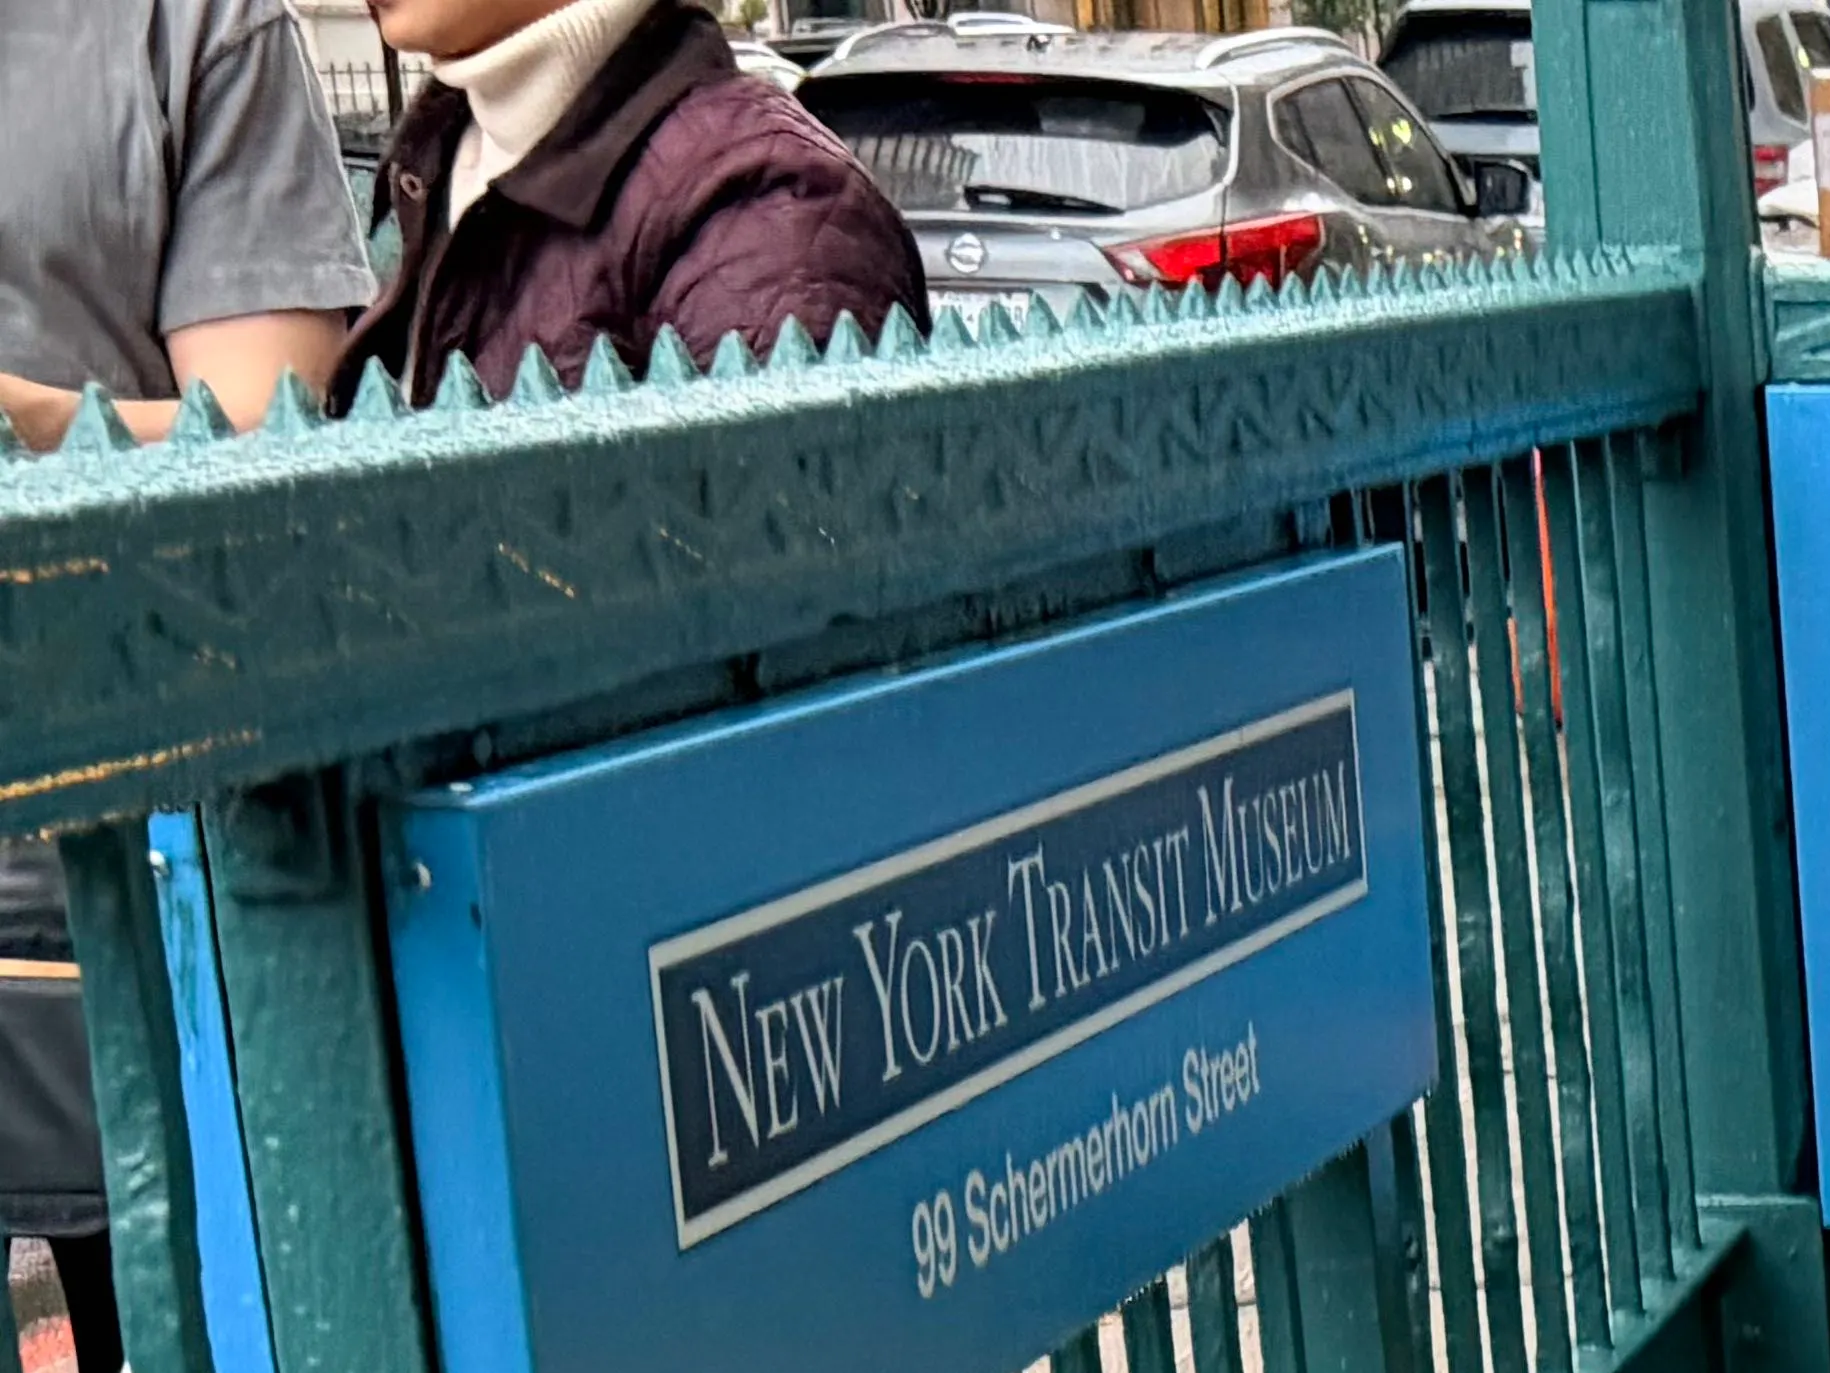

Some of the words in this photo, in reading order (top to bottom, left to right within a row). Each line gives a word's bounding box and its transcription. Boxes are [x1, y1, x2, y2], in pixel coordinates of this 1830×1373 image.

[911, 1189, 957, 1298] 99
[966, 1082, 1178, 1268] Schermerhorn
[1182, 1022, 1261, 1135] Street
